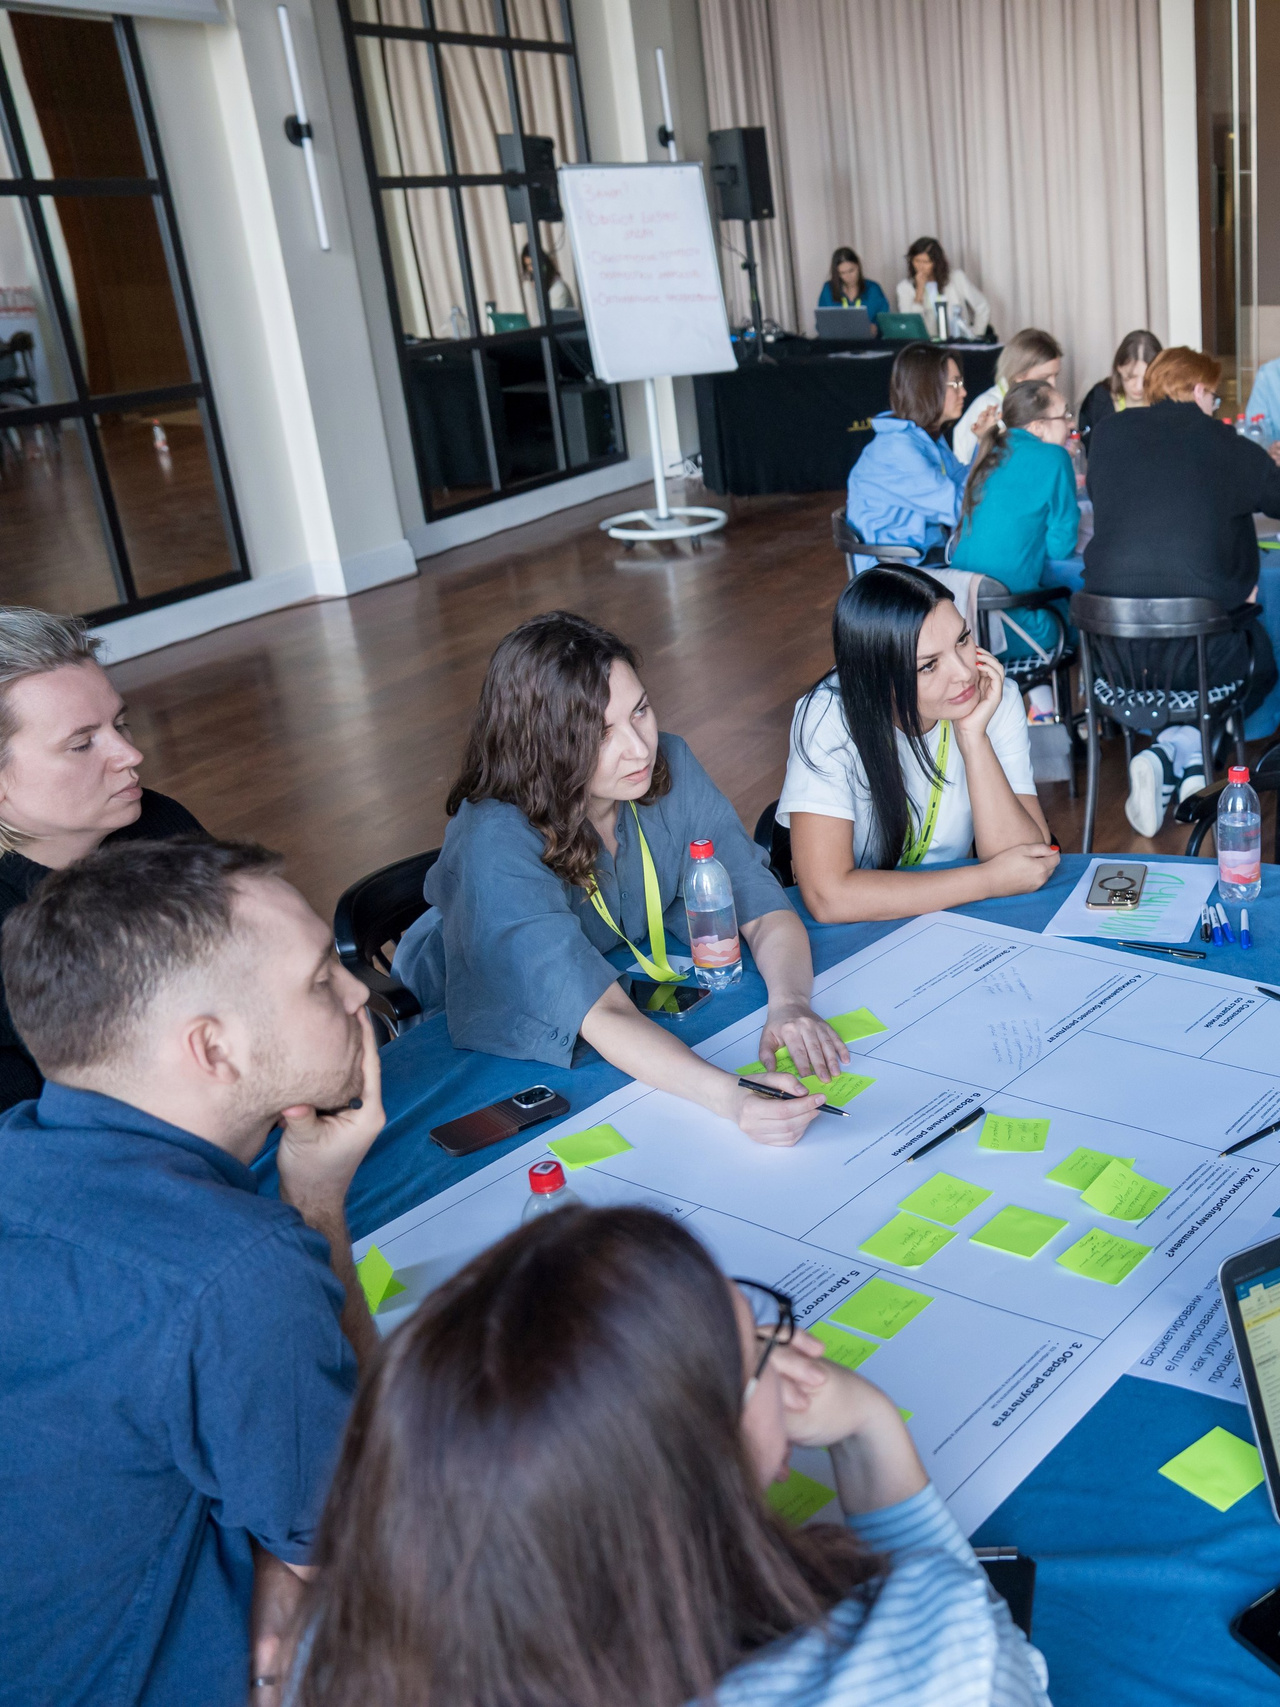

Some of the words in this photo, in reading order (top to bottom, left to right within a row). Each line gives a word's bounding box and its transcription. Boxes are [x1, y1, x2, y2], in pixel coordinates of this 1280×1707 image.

[1077, 1005, 1101, 1020] бизнес
[1204, 1003, 1236, 1027] стратегией
[1047, 1020, 1079, 1042] результат
[927, 1098, 974, 1130] Возможные
[892, 1130, 928, 1156] решения
[1229, 1174, 1254, 1194] Какую
[1196, 1195, 1231, 1226] проблему
[1165, 1226, 1199, 1257] решаем?
[828, 1277, 850, 1292] Для
[802, 1293, 829, 1315] кого?
[1140, 1294, 1203, 1367] Бюджетировани
[1043, 1351, 1073, 1377] Образ
[1190, 1355, 1208, 1373] как
[992, 1377, 1045, 1426] результата
